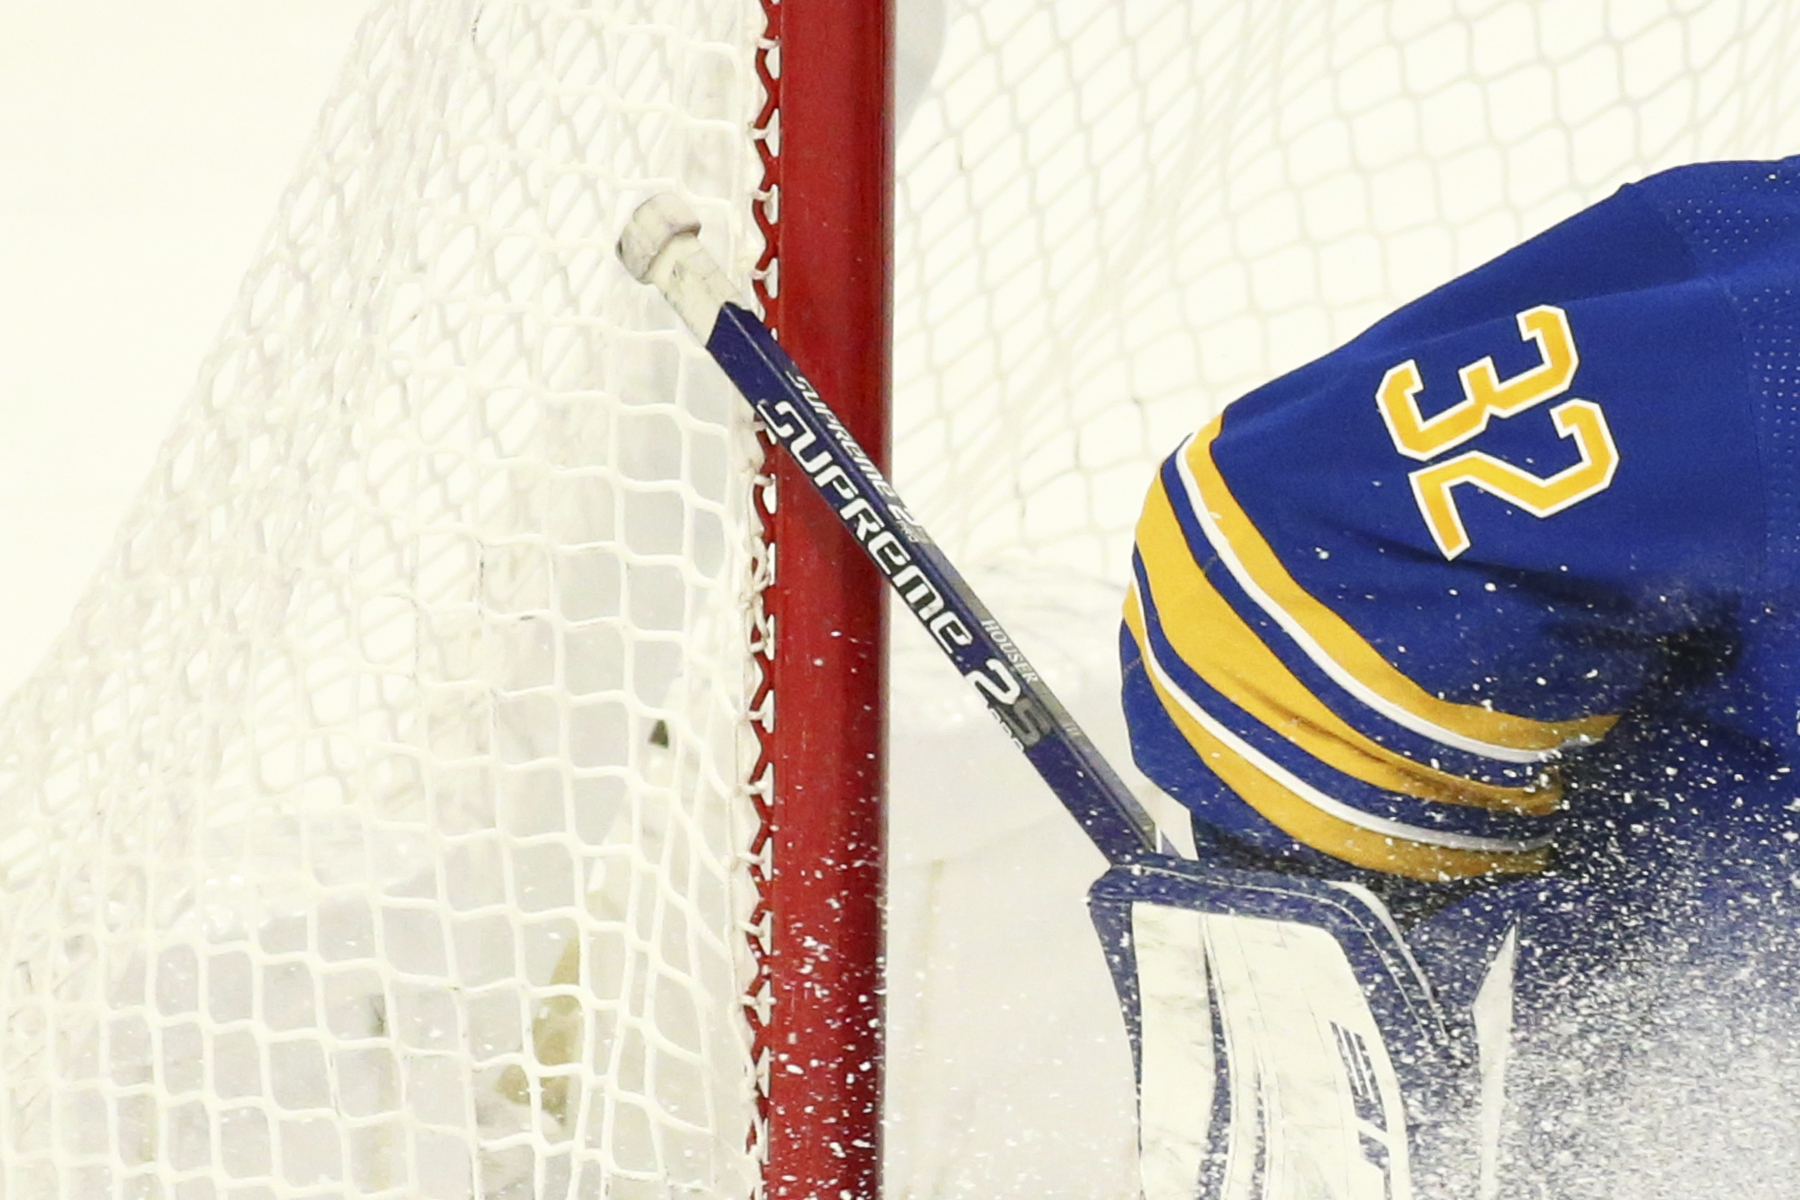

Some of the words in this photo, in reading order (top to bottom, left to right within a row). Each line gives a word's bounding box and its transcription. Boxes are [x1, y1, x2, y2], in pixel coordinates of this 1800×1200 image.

[757, 399, 974, 655] SUPREME
[1376, 304, 1621, 561] 32
[980, 618, 1039, 684] HOUSER
